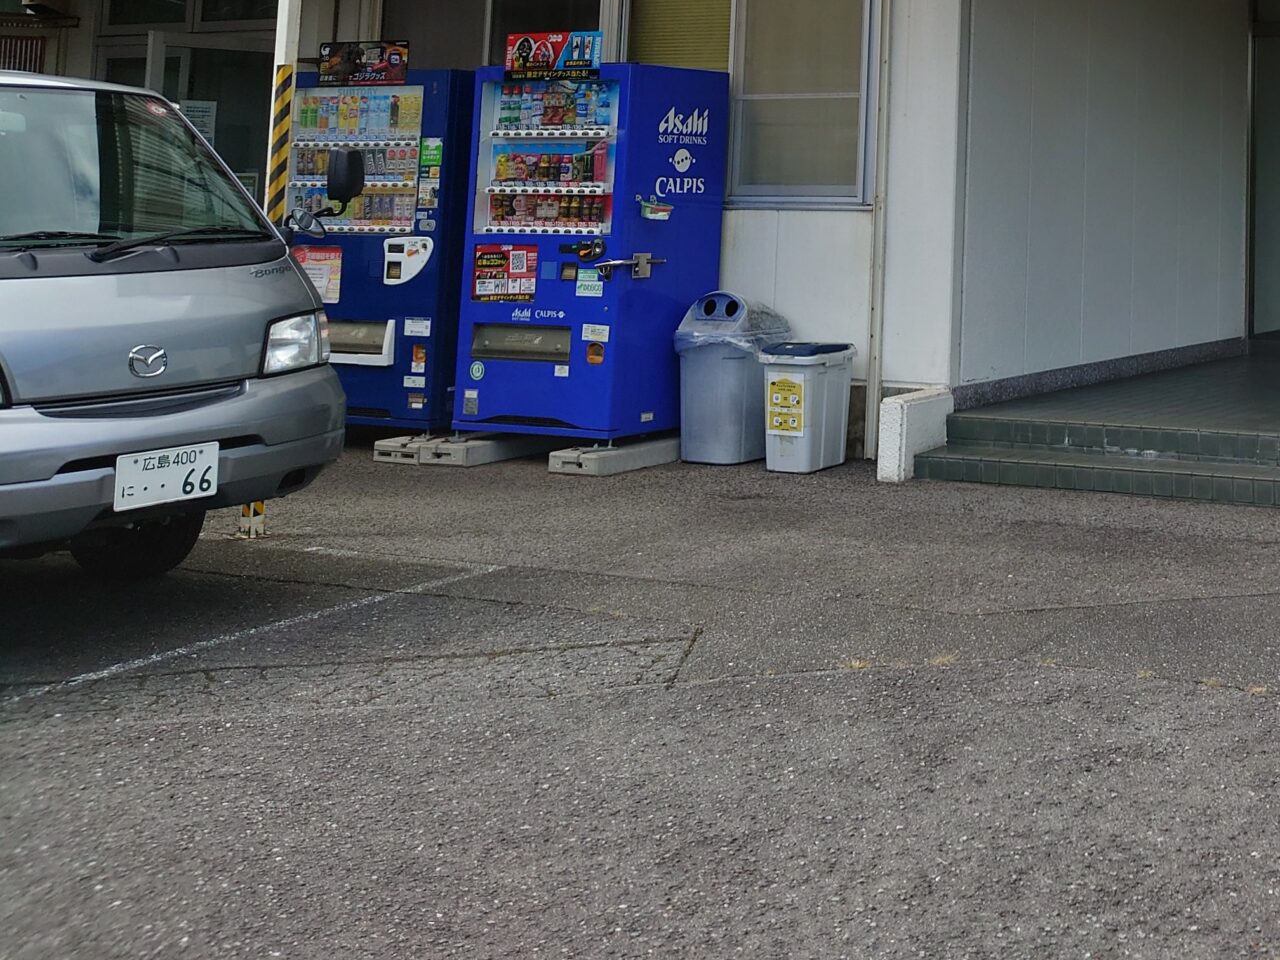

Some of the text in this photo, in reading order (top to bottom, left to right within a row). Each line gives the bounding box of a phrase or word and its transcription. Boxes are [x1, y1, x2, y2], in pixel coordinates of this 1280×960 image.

[337, 87, 378, 96] SUNTORY
[658, 106, 709, 136] Asahi
[658, 134, 708, 145] SOFT DRINKS
[655, 176, 705, 197] CALPIS
[250, 264, 292, 278] Bongo
[512, 307, 558, 319] Asahi CALPIS
